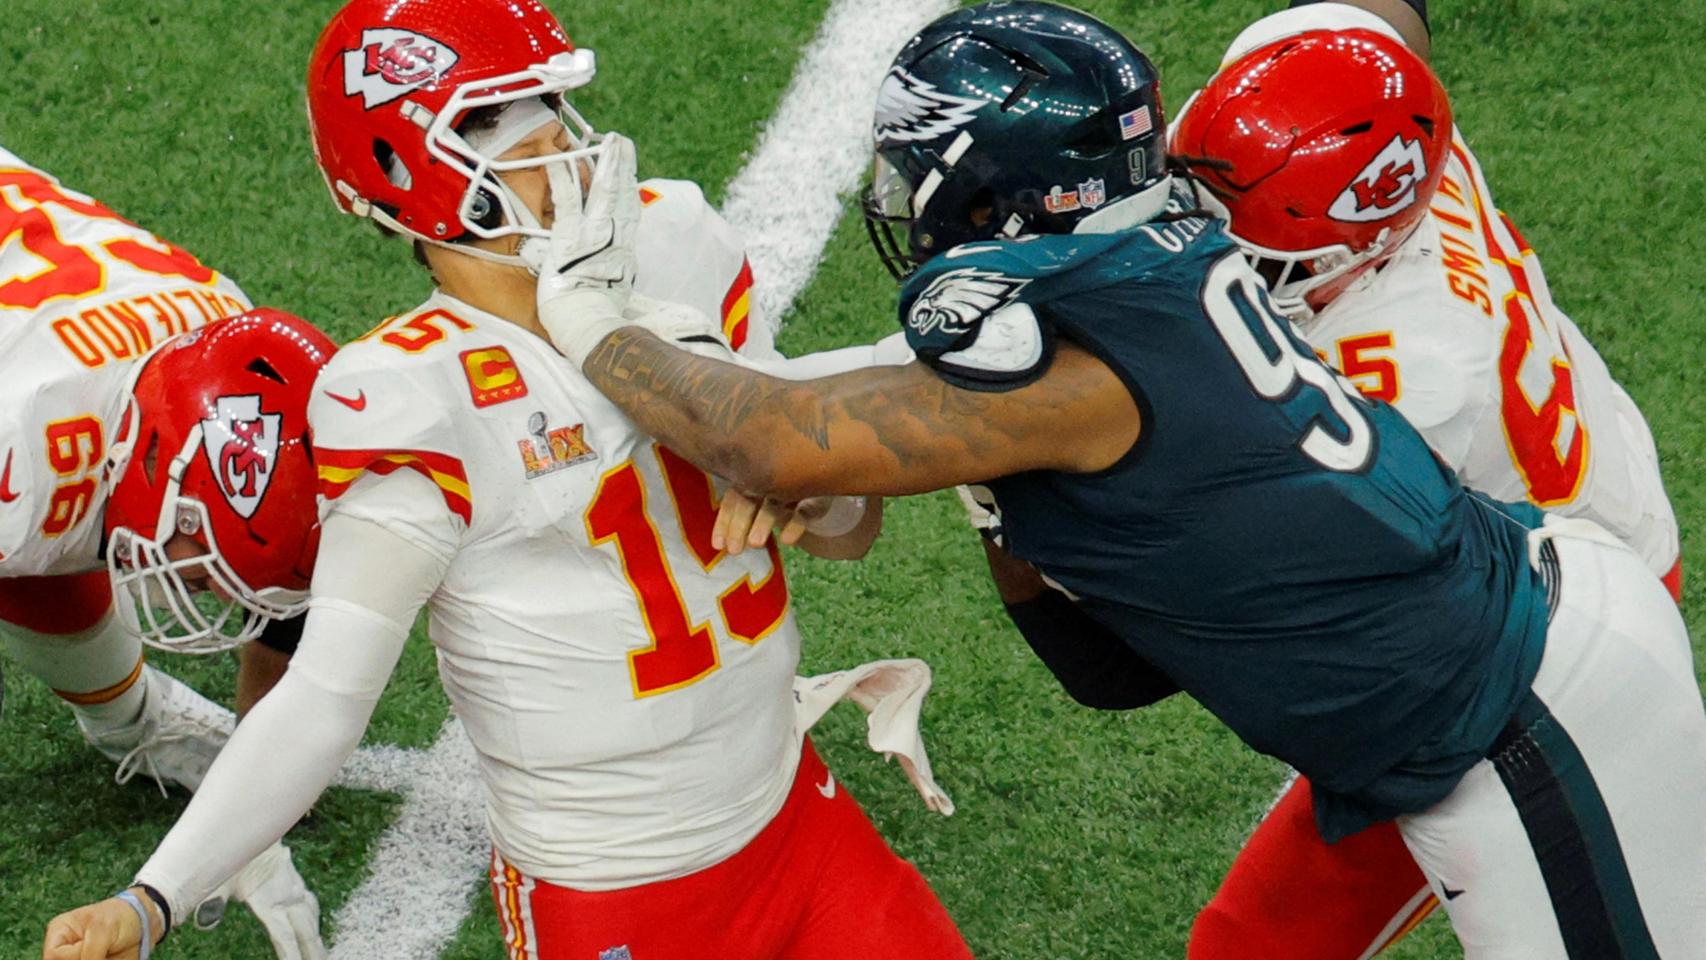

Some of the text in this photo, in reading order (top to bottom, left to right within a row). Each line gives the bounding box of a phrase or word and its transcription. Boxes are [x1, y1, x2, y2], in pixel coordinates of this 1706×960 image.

[1127, 147, 1147, 186] 9
[352, 307, 477, 355] 5
[466, 349, 518, 391] C
[1200, 248, 1377, 474] 9
[1314, 330, 1402, 405] 5
